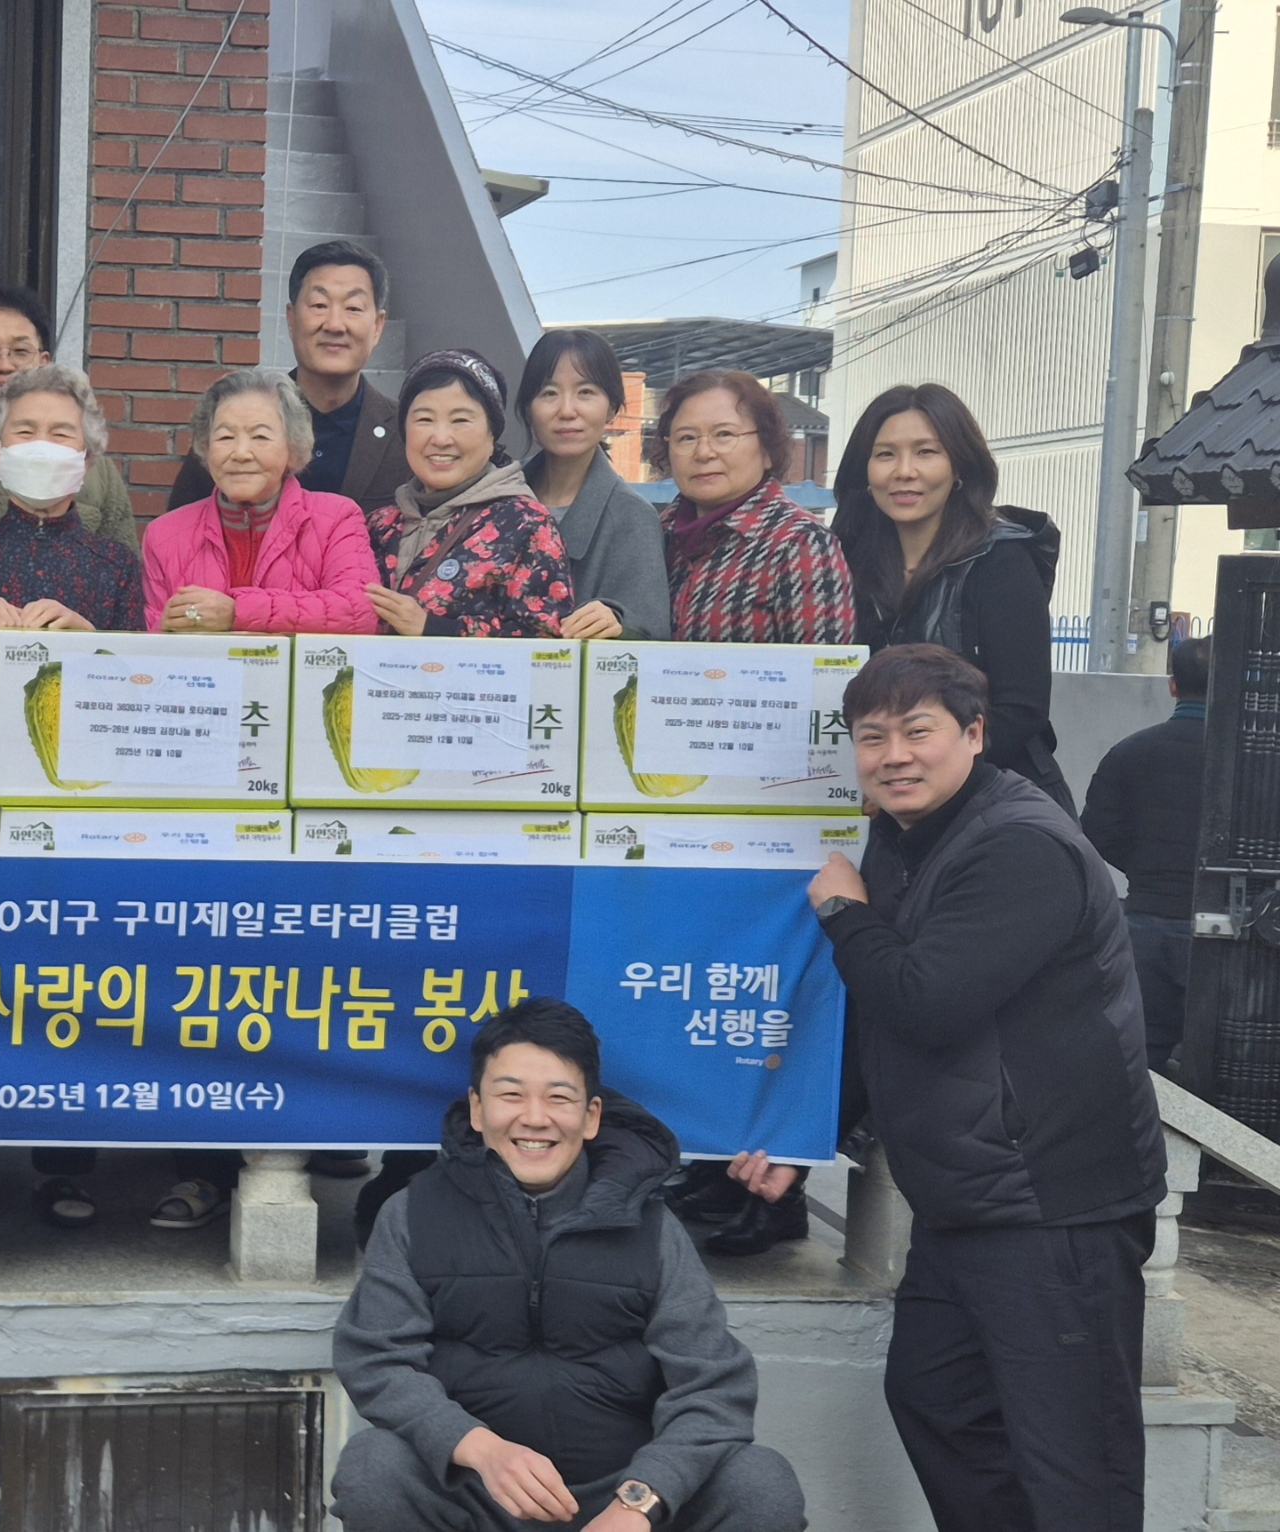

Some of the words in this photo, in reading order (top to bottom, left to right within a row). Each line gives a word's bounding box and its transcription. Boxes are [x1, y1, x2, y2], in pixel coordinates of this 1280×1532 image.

[379, 662, 417, 670] Rotary
[87, 674, 127, 682] Rotary
[662, 669, 700, 677] Rotary
[367, 689, 405, 698] 국제로타리
[408, 690, 441, 700] 3630지구
[445, 691, 475, 701] 구미제일
[479, 693, 517, 702] 로타리클럽
[75, 702, 113, 711] 국제로타리
[117, 703, 151, 713] 3630지구
[155, 704, 185, 714] 구미제일
[189, 705, 228, 715] 로타리클럽
[651, 696, 687, 705] 국제로타리
[691, 697, 724, 707] 3630지구
[727, 699, 757, 708] 구미제일
[761, 700, 798, 709] 로타리클럽
[382, 712, 420, 721] 2025-26년
[425, 713, 447, 722] 사랑의
[451, 714, 481, 723] 김장나눔
[485, 715, 500, 724] 봉사
[528, 704, 563, 740] 추
[665, 718, 703, 728] 2025-26년
[706, 719, 729, 729] 사랑의
[732, 720, 762, 730] 김장나눔
[766, 721, 781, 731] 봉사
[89, 724, 129, 734] 2025-26년
[133, 725, 156, 735] 사랑의
[160, 727, 191, 736] 김장나눔
[195, 728, 210, 737] 봉사
[407, 734, 433, 744] 2025년
[437, 735, 453, 744] 12월
[457, 736, 473, 745] 10일
[689, 741, 714, 750] 2025년
[718, 742, 734, 751] 12월
[738, 742, 754, 751] 10일
[115, 747, 141, 757] 2025년
[145, 748, 162, 757] 12월
[166, 749, 182, 758] 10일
[247, 780, 279, 794] 20kg
[541, 782, 571, 796] 20kg
[828, 787, 858, 801] 20kg
[113, 901, 459, 941] 구미제일로타리클럽
[620, 962, 692, 1001] 우리
[706, 962, 780, 1002] 함께
[171, 965, 395, 1052] 김장나눔
[414, 967, 530, 1053] 봉사
[684, 1008, 794, 1048] 선행을
[735, 1056, 764, 1067] Rotary
[97, 1083, 159, 1110] 12월
[169, 1083, 285, 1113] 10일(수)
